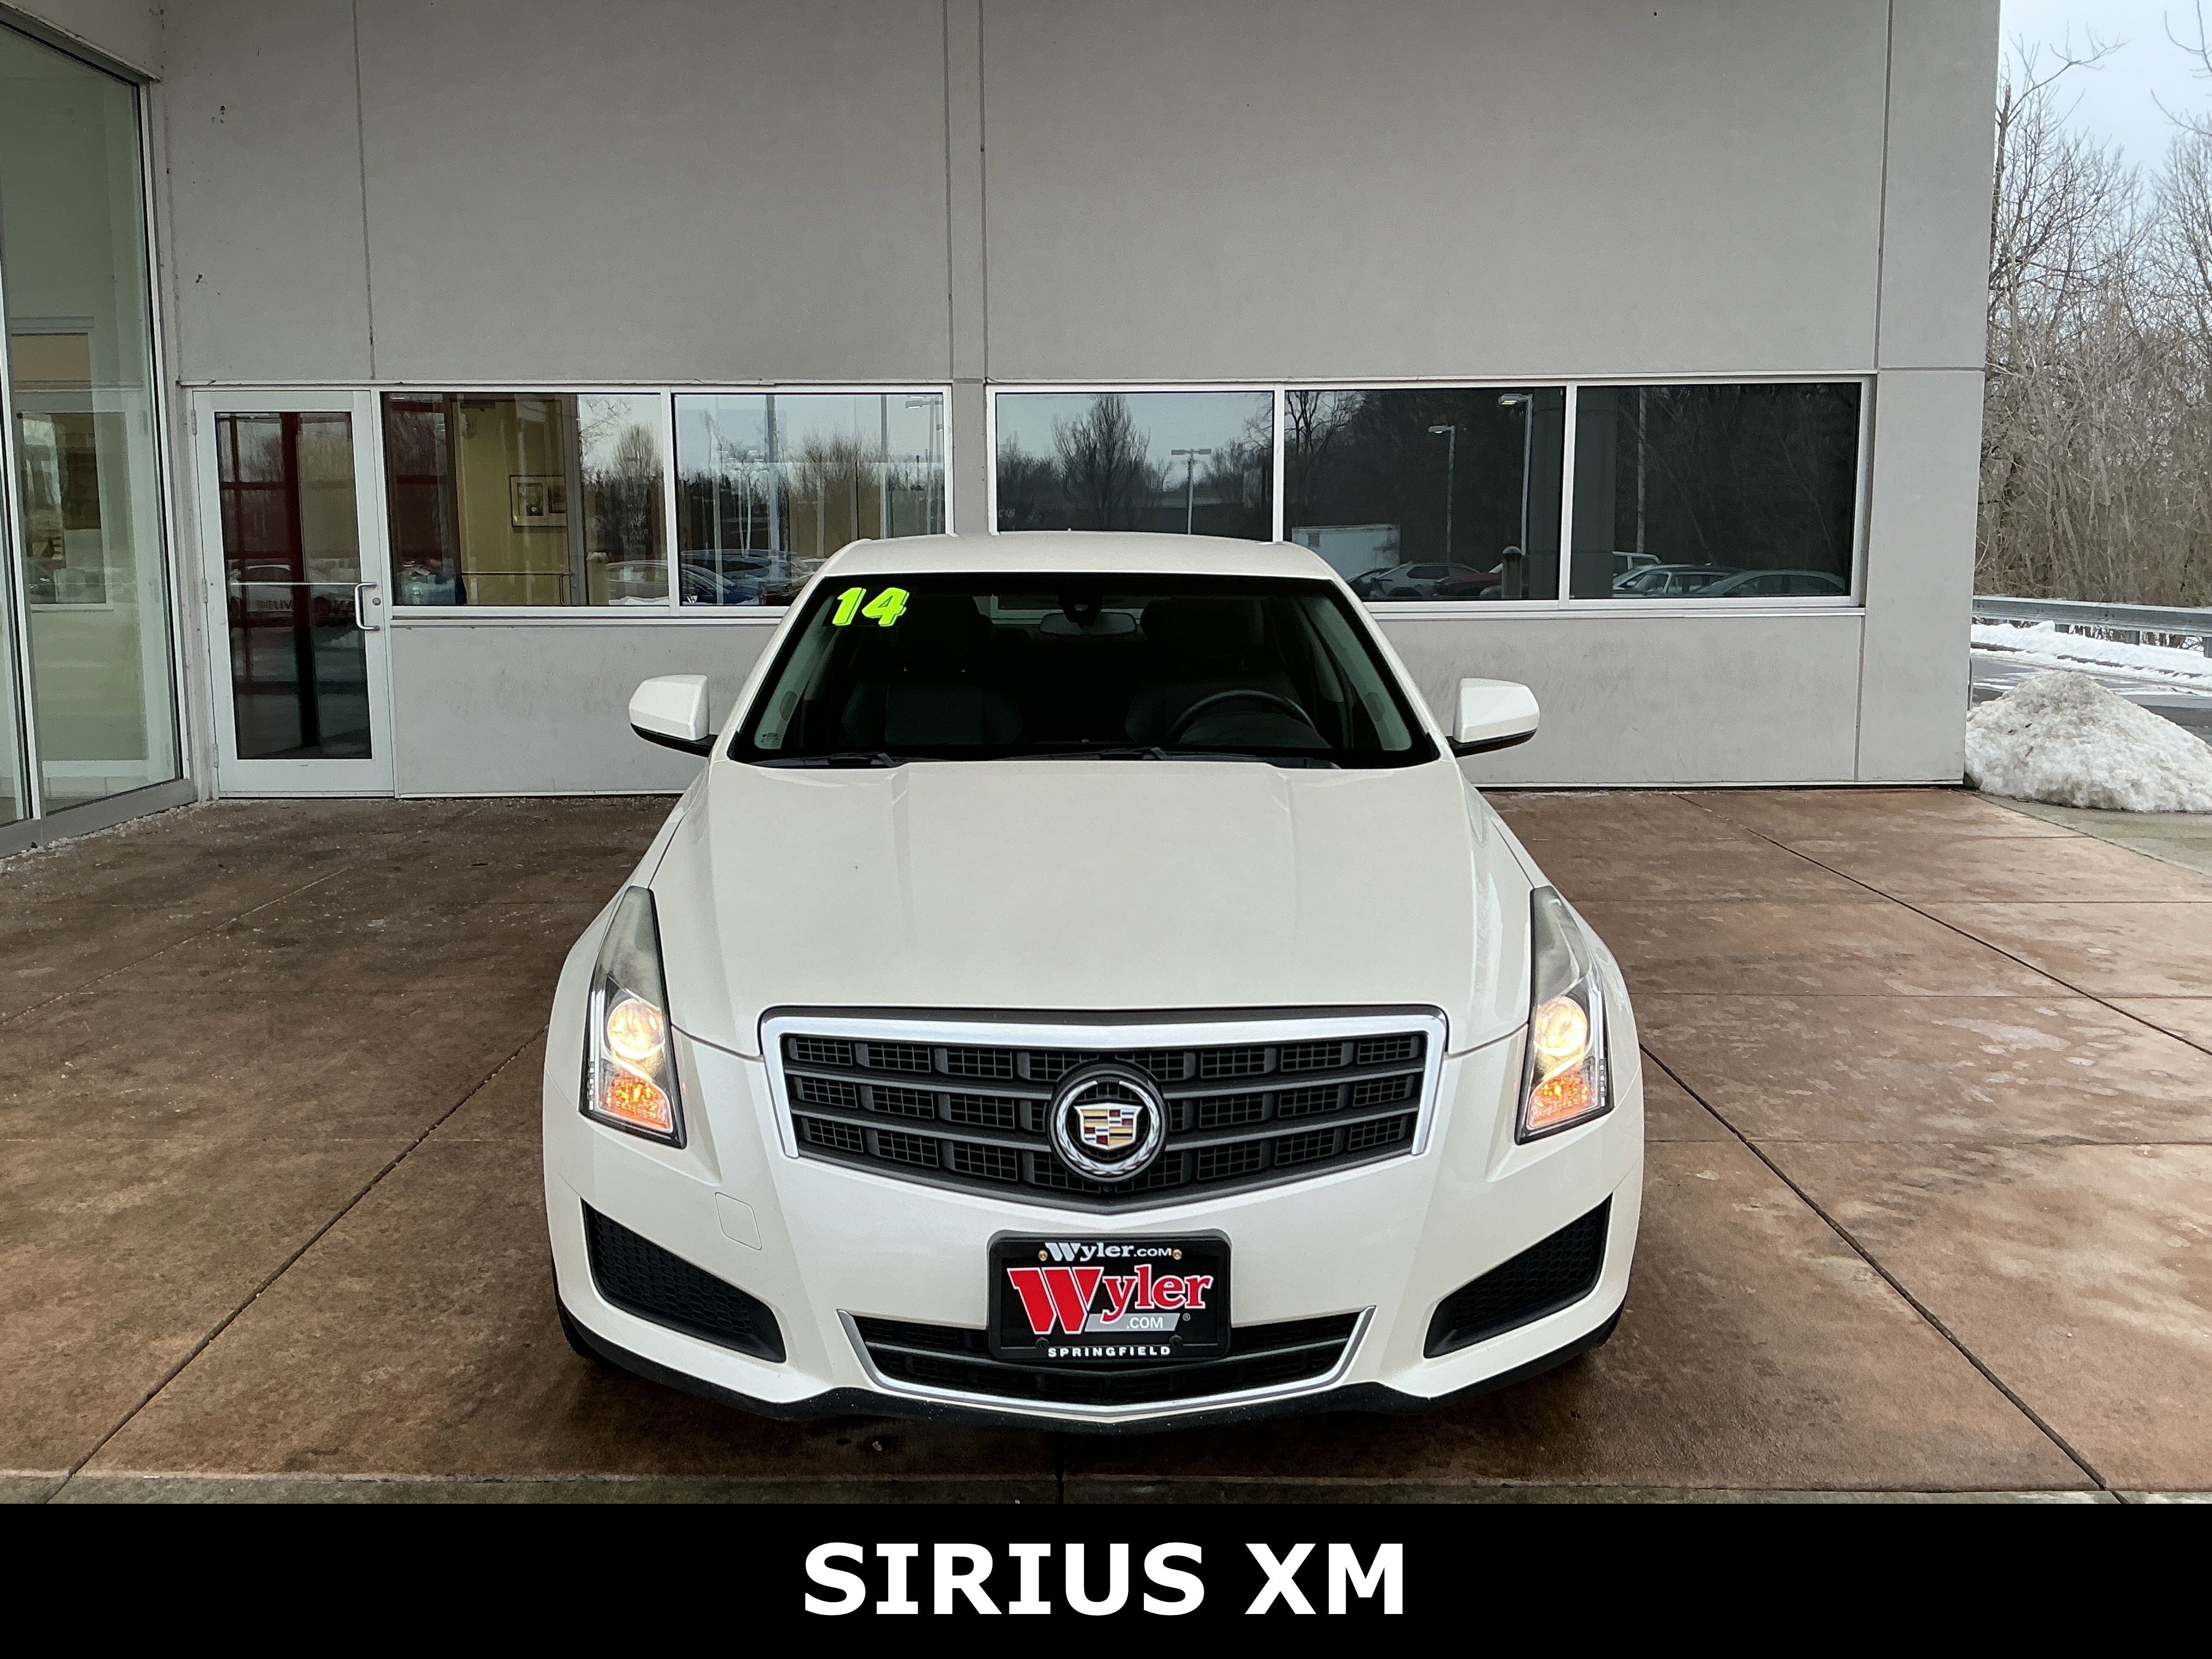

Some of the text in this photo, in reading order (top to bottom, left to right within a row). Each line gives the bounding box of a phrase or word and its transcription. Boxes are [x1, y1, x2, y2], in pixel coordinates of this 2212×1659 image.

[832, 587, 910, 627] 14
[1007, 1263, 1214, 1335] Wyler
[1126, 1317, 1164, 1329] .COM
[1048, 1346, 1171, 1358] SPRINGFIELD
